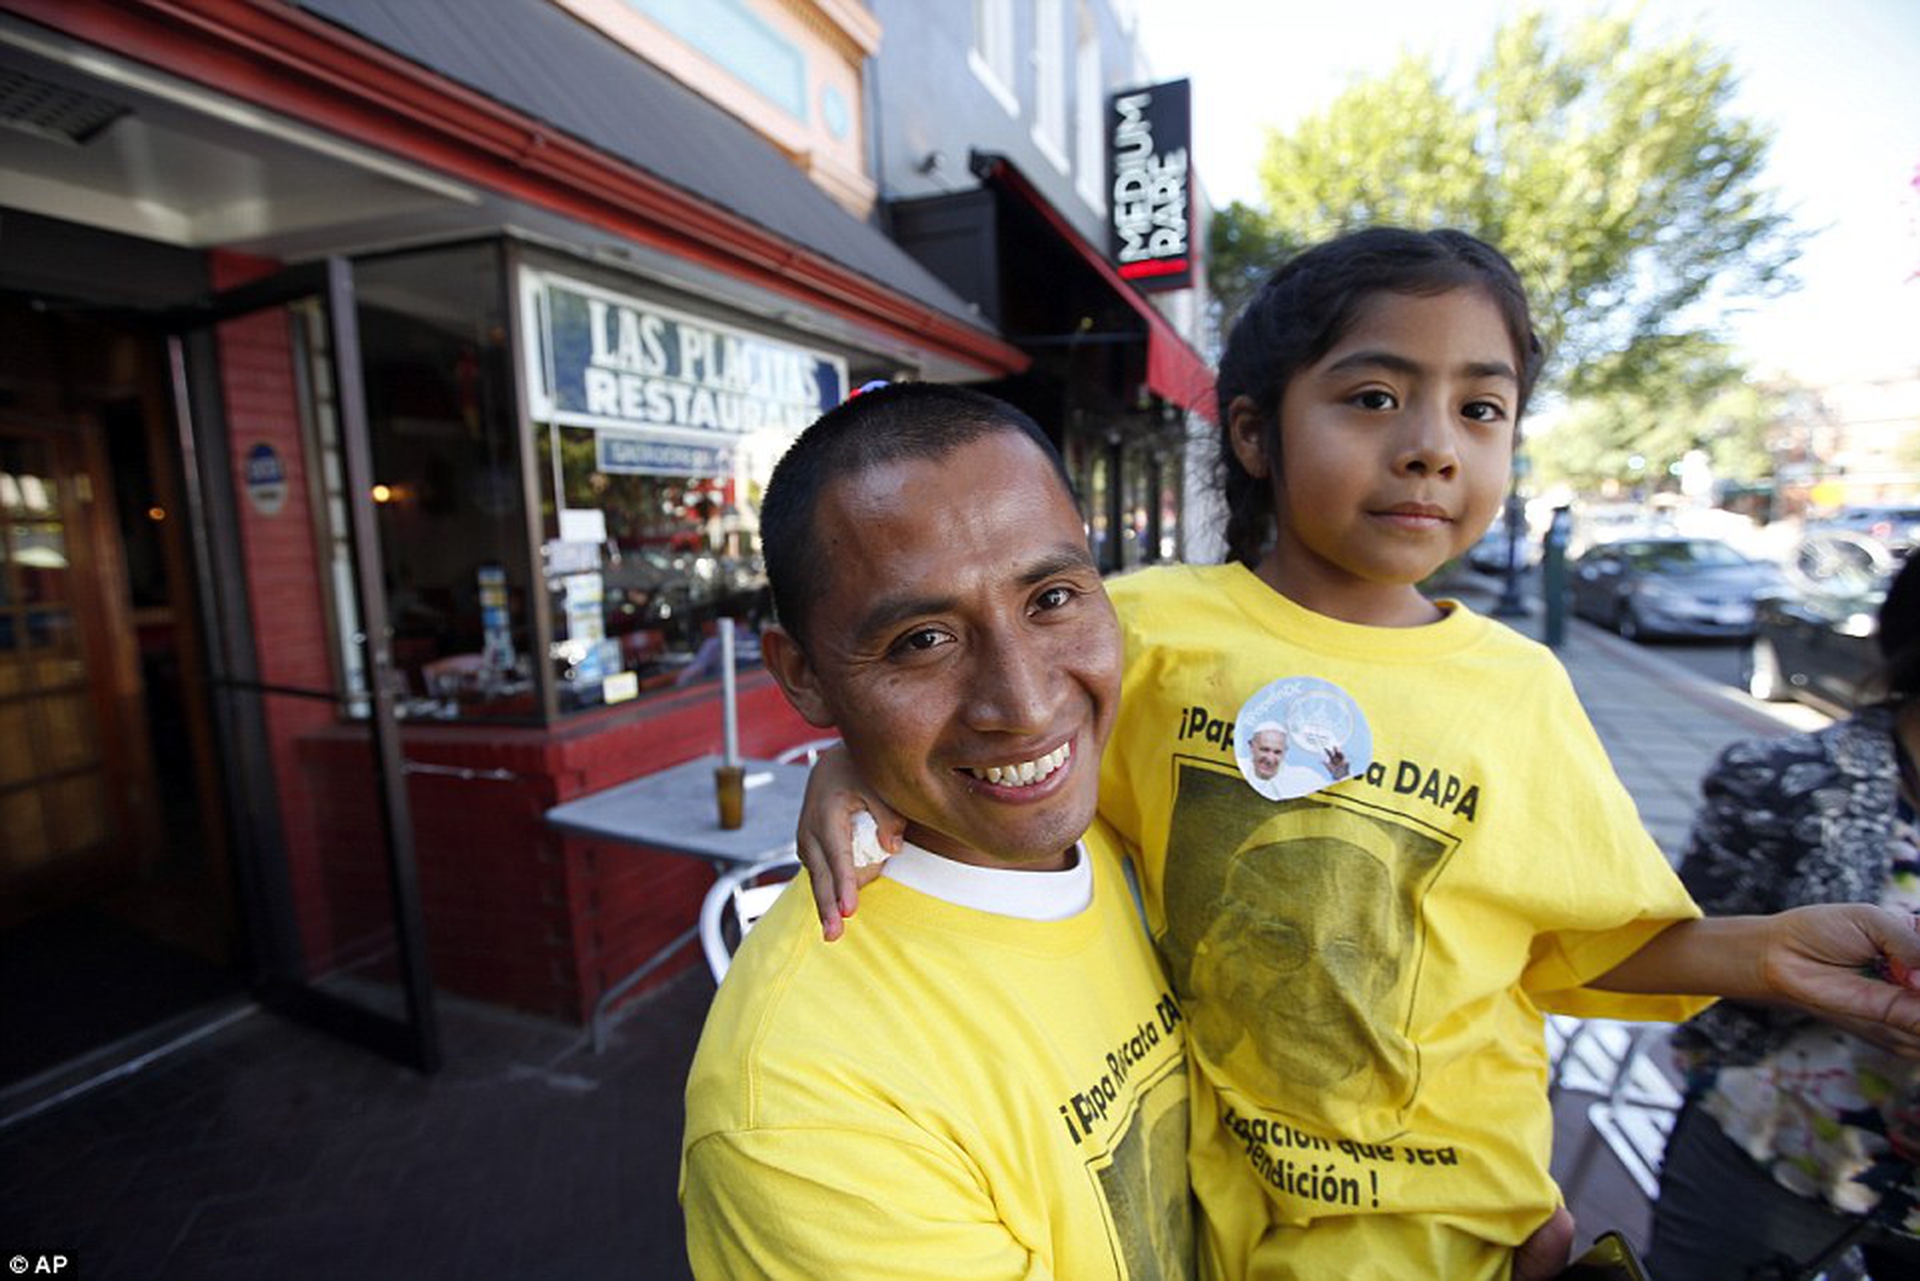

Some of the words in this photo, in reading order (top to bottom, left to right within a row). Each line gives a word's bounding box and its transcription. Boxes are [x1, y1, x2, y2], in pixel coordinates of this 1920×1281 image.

[1114, 92, 1153, 262] MEDIUM
[1148, 147, 1187, 259] RARE
[588, 300, 667, 377] LAS
[585, 367, 824, 432] RESTAURAN
[1178, 705, 1235, 751] ¡Pap
[1393, 759, 1479, 822] DAPA
[1337, 1138, 1395, 1163] que
